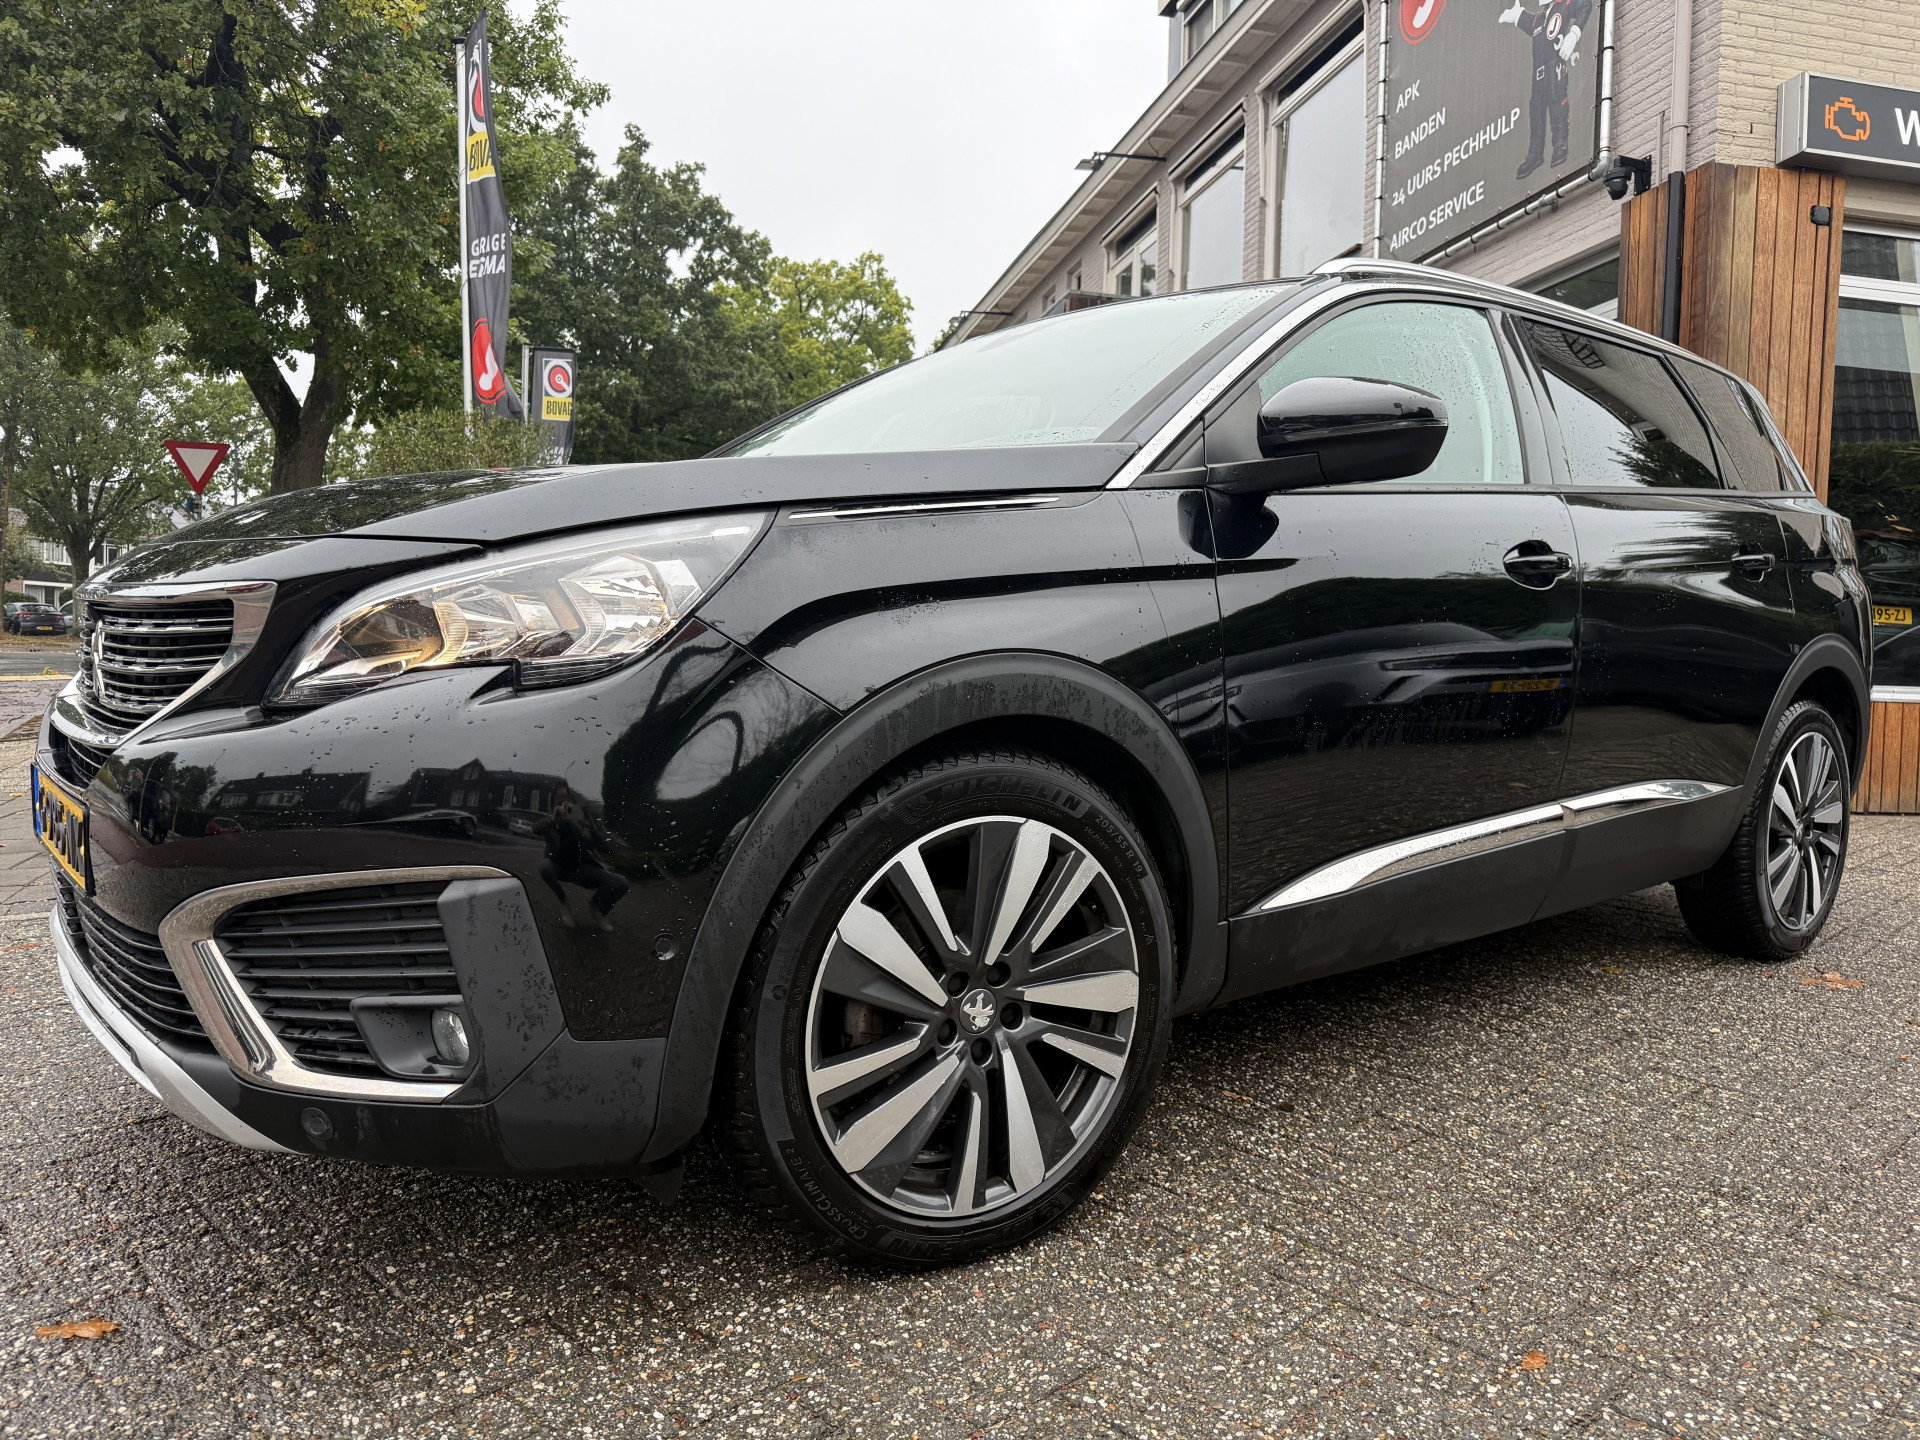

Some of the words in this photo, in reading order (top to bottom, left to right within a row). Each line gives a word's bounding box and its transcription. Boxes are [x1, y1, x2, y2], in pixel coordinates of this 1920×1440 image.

[1395, 79, 1420, 114] APK
[1392, 188, 1406, 207] 24
[1407, 158, 1441, 195] UURS
[1443, 107, 1520, 173] PECHHULP
[1394, 106, 1446, 160] BANDEN
[1389, 216, 1427, 253] AIRCO
[1428, 180, 1485, 230] SERVICE
[1094, 814, 1129, 850] 205/55
[1125, 849, 1135, 860] R
[1132, 860, 1143, 873] 19
[790, 1156, 868, 1240] CROSSCLIMATE
